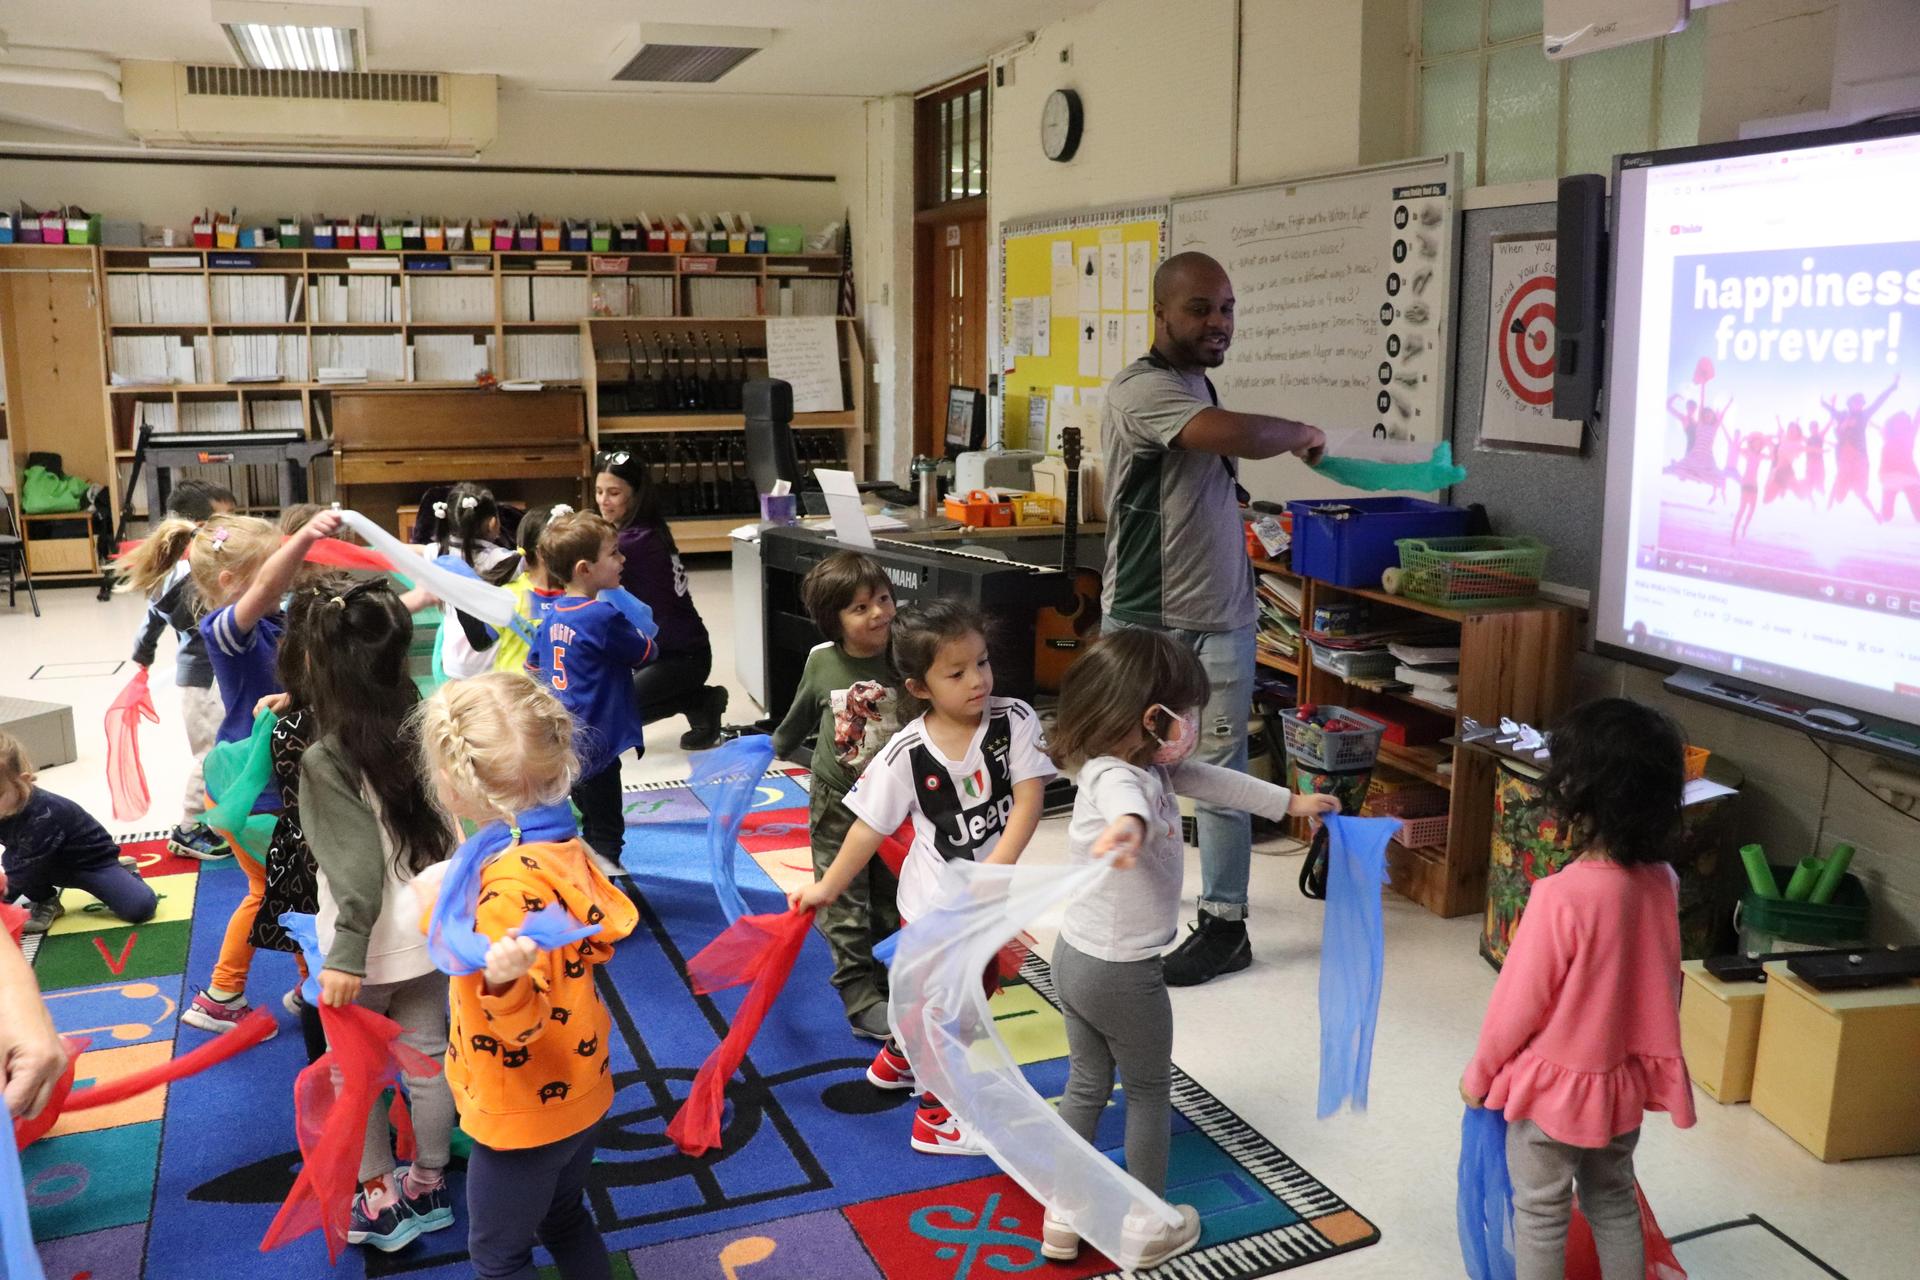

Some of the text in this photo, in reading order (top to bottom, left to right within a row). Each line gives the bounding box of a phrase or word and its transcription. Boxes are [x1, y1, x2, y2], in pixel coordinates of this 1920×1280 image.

[1535, 242, 1551, 255] you
[1715, 311, 1903, 365] forever!
[882, 566, 918, 590] AMAHA
[551, 645, 568, 691] 5
[948, 794, 1014, 847] Jeep
